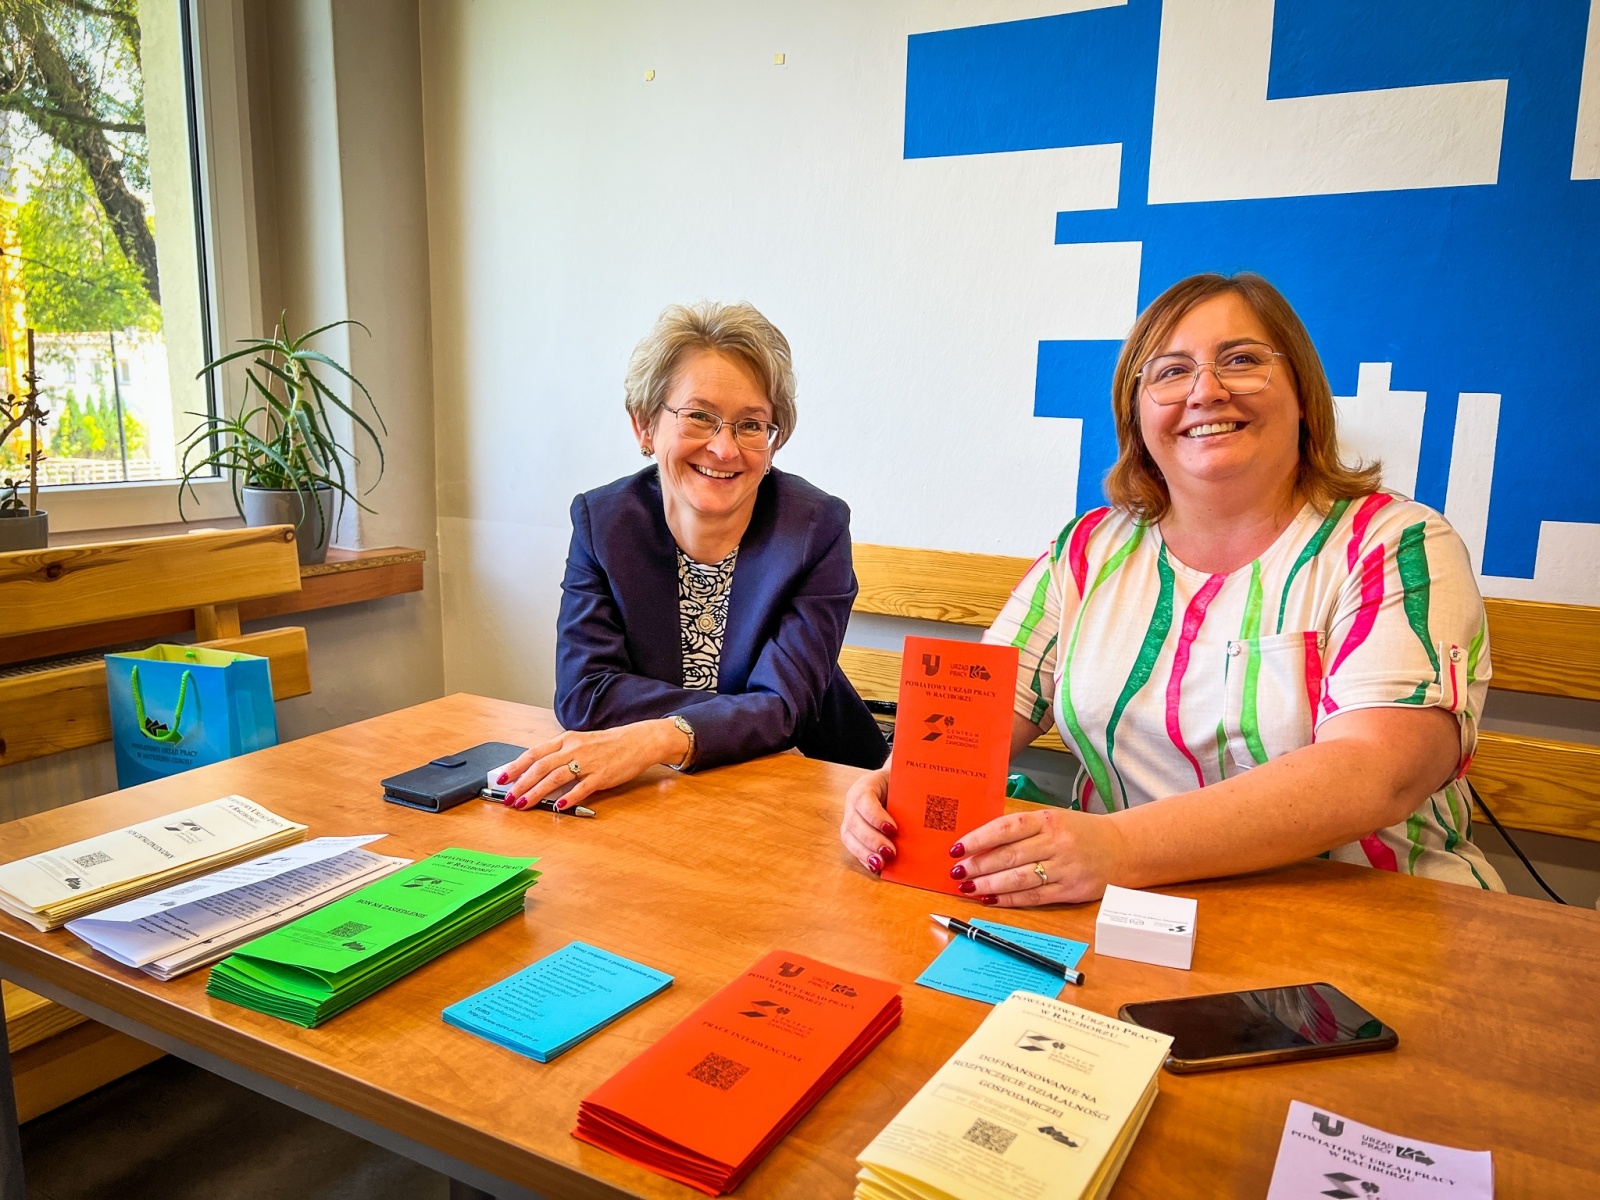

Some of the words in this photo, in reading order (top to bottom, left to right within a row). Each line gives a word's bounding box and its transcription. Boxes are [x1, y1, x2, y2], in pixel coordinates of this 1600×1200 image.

[905, 680, 946, 691] POWIATOWY
[973, 689, 996, 698] PRACY
[933, 691, 973, 702] RACIBORZU
[179, 749, 198, 757] PRACY
[906, 760, 926, 768] PRACE
[929, 764, 988, 779] INTERWENCYJNE
[356, 898, 371, 907] BON
[381, 905, 428, 919] ZASIEDLENIE
[748, 972, 797, 991] POWIATOWY
[828, 999, 855, 1010] PRACY
[777, 987, 825, 1006] RACIBORZU
[1011, 994, 1076, 1017] POWIATOWY
[1124, 1027, 1162, 1044] PRACY
[1053, 1011, 1119, 1039] RACIBORZU
[702, 1021, 728, 1033] PRACE
[731, 1031, 802, 1063] INTERWENCYJNE
[952, 1059, 1026, 1088] ROZPOCZĘCIE
[1027, 1083, 1111, 1122] DZIAŁALNOŚCI
[979, 1053, 1080, 1095] DOFINANSOWANIE
[1081, 1092, 1097, 1104] NA
[979, 1079, 1064, 1118] GOSPODARCZEJ
[1291, 1130, 1367, 1161] POWIATOWY
[1369, 1157, 1411, 1175] URZĄD
[1414, 1170, 1456, 1186] PRACY
[1361, 1140, 1392, 1156] PRACY
[1343, 1155, 1415, 1182] RACIBORZU
